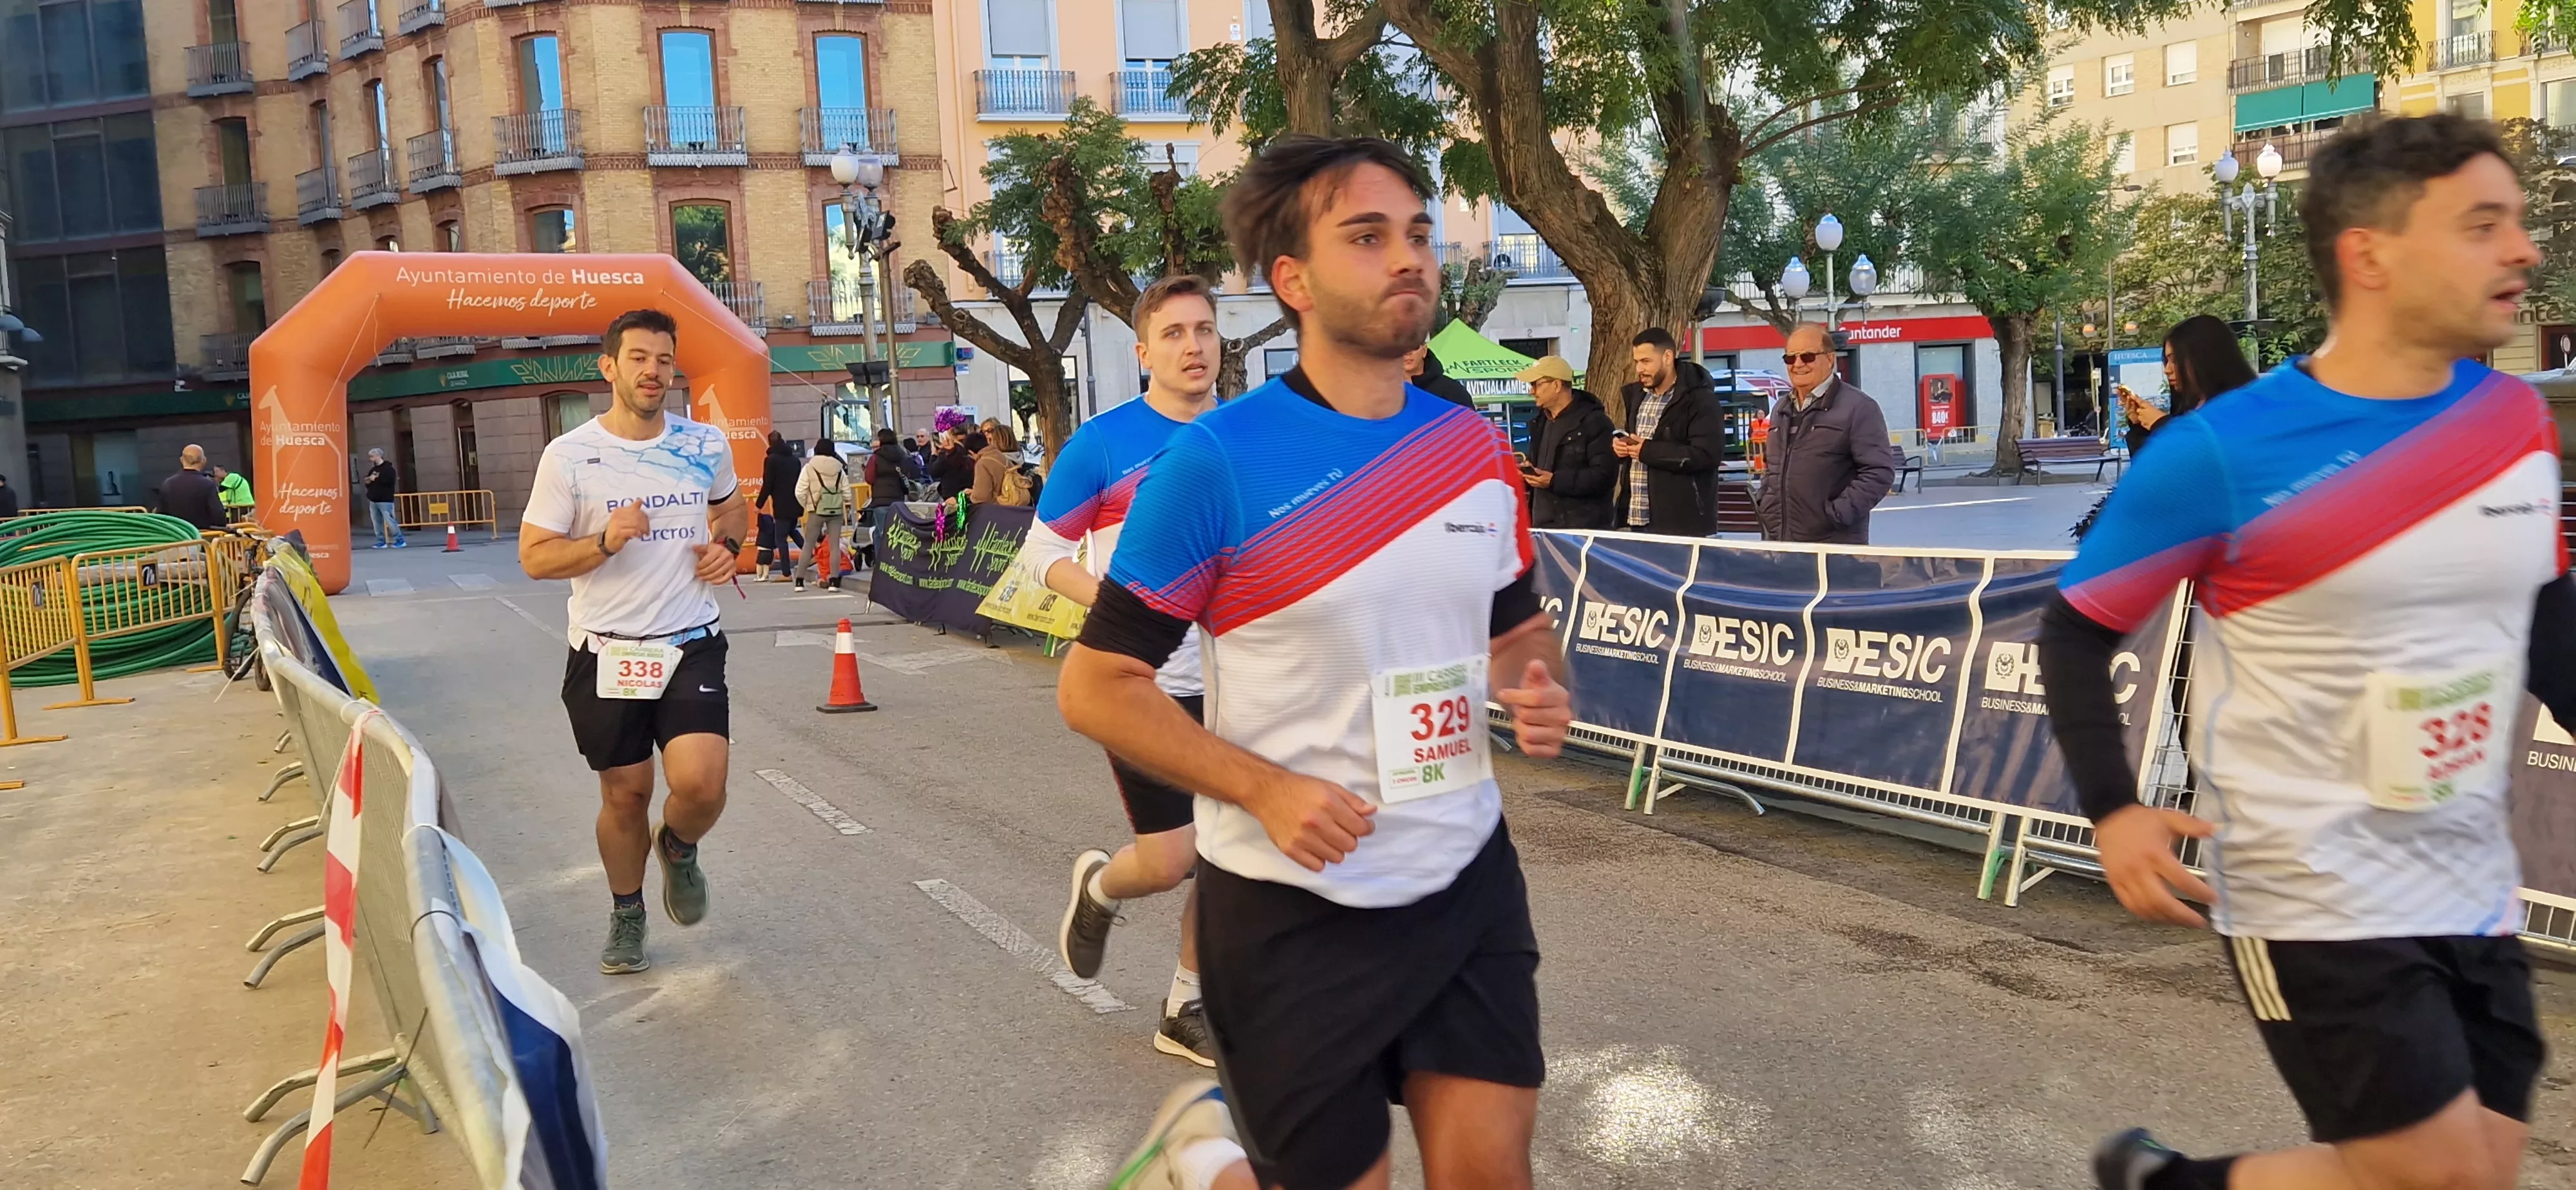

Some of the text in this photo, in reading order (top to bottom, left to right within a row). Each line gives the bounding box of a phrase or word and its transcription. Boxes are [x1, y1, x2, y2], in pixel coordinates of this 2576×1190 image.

[396, 266, 645, 287] Ayuntamiento de Huesca
[446, 288, 598, 317] Hacemos deporte
[1527, 328, 1533, 337] 2
[1839, 325, 1902, 340] antander
[1466, 380, 1531, 395] AVITUALLAMIEN
[260, 420, 340, 435] Ayuntamiento
[724, 431, 757, 440] uesca
[260, 435, 325, 446] de Huesca
[278, 482, 338, 500] Hacemos
[279, 498, 332, 522] deporte
[1600, 604, 1669, 648] ESIC
[1716, 616, 1795, 666] ESIC
[1853, 630, 1951, 684] ESIC
[618, 660, 663, 678] 338
[617, 679, 663, 688] NICOLAS
[623, 688, 638, 696] 8K
[1410, 695, 1471, 741] 329
[1414, 738, 1473, 763] SAMUEL
[1421, 762, 1445, 784] 8K
